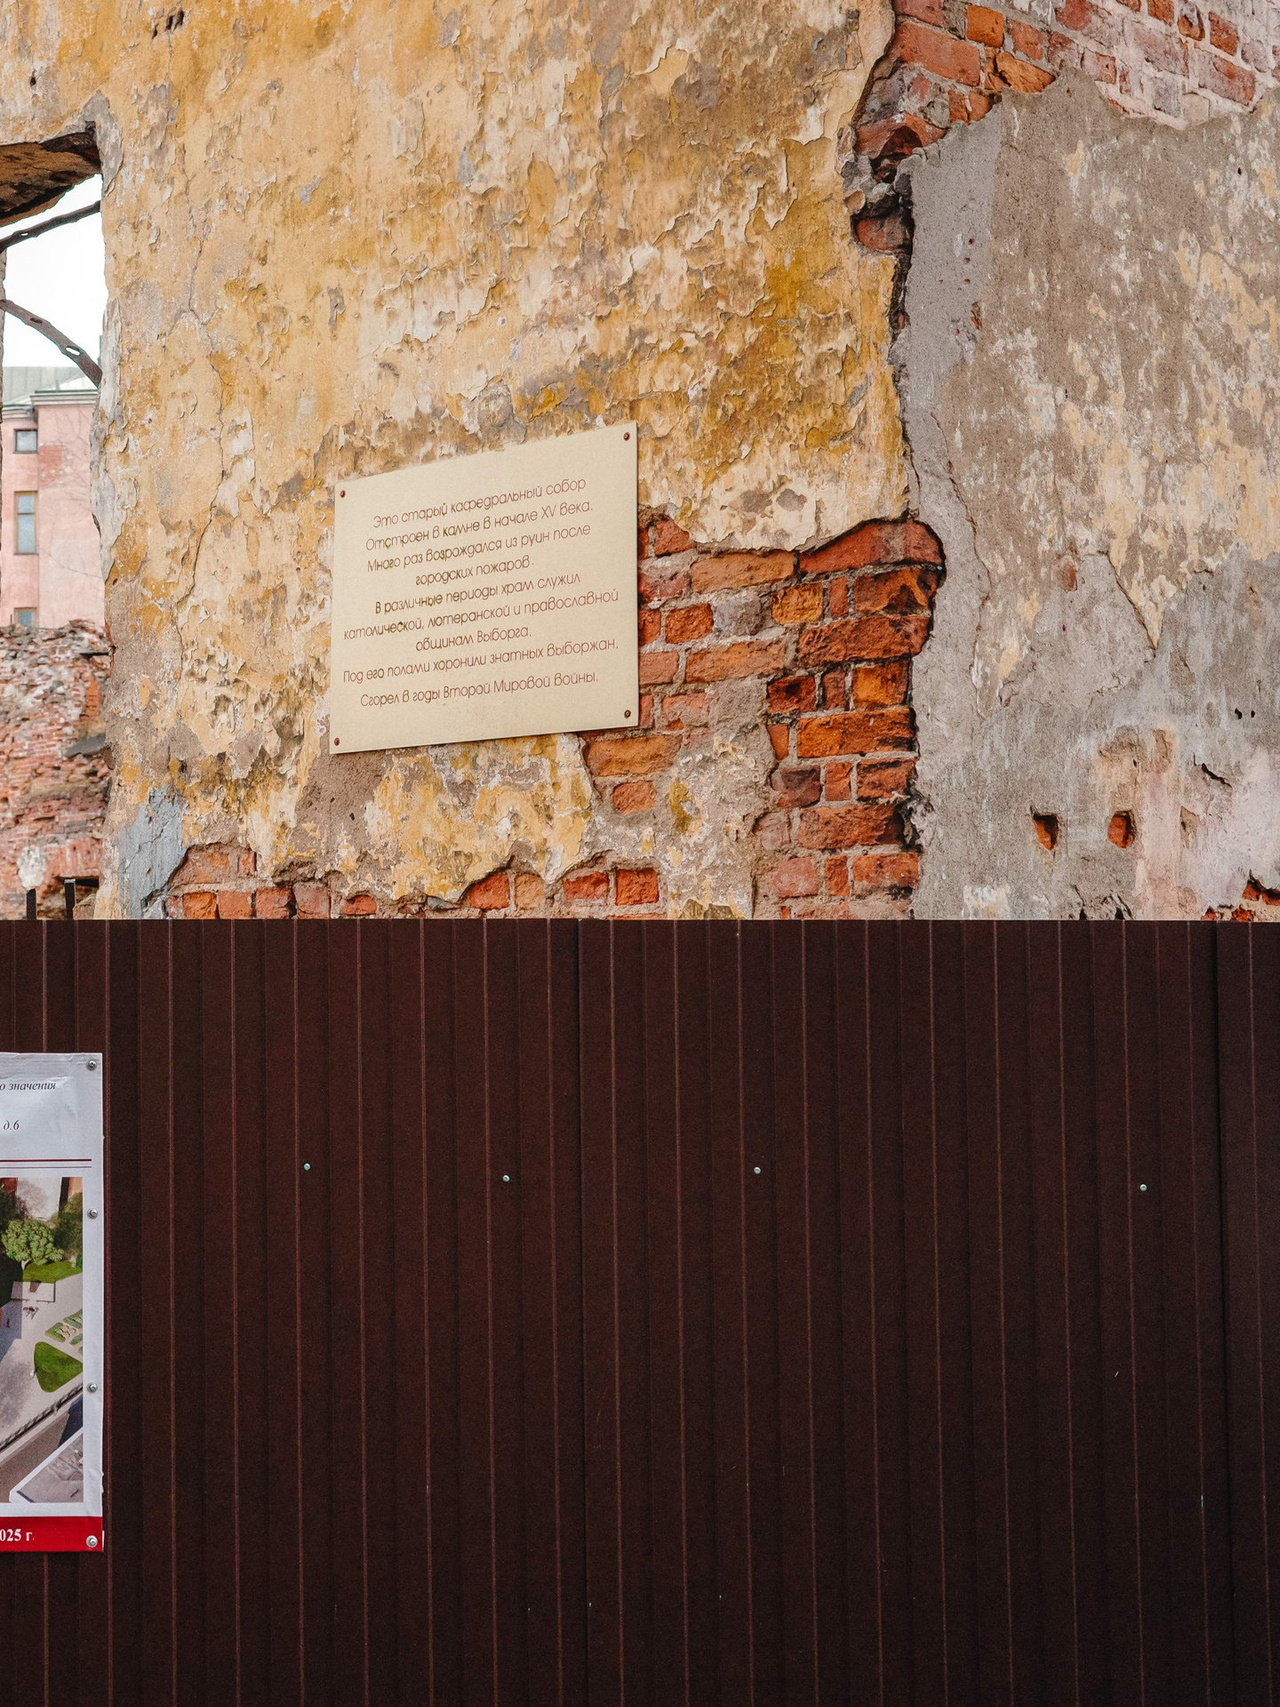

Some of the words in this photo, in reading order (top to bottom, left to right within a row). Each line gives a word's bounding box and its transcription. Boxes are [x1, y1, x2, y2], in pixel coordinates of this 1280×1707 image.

[373, 515, 398, 529] Это
[402, 502, 447, 523] старый
[451, 485, 542, 514] кафедральный
[546, 478, 586, 496] собор
[366, 530, 429, 551] Отстроен
[443, 521, 480, 537] камне
[495, 510, 538, 528] начале
[541, 504, 556, 519] XV
[560, 501, 592, 516] века.
[368, 557, 400, 573] Много
[404, 553, 423, 569] раз
[426, 539, 502, 562] возрождался
[506, 537, 517, 549] из
[521, 532, 549, 548] руин
[554, 525, 590, 540] после
[416, 567, 473, 586] городских
[476, 554, 533, 576] пожаров.
[376, 601, 381, 615] В
[385, 593, 443, 616] различные
[446, 585, 498, 603] периоды
[501, 580, 534, 596] храм
[538, 573, 580, 590] служил
[344, 617, 424, 640] католической,
[428, 604, 510, 629] лютеранской
[514, 605, 520, 616] и
[525, 588, 618, 616] православной
[416, 634, 474, 652] общинам
[344, 670, 363, 685] Под
[367, 667, 384, 681] его
[388, 662, 430, 677] полами
[433, 655, 486, 673] хоронили
[490, 647, 543, 665] знатных
[361, 694, 399, 707] Сгорел
[413, 689, 440, 704] годы
[444, 683, 490, 698] Второй
[494, 675, 550, 694] Мировой
[554, 672, 598, 687] войны.
[9, 1083, 55, 1091] значения
[3, 1120, 19, 1130] д.6
